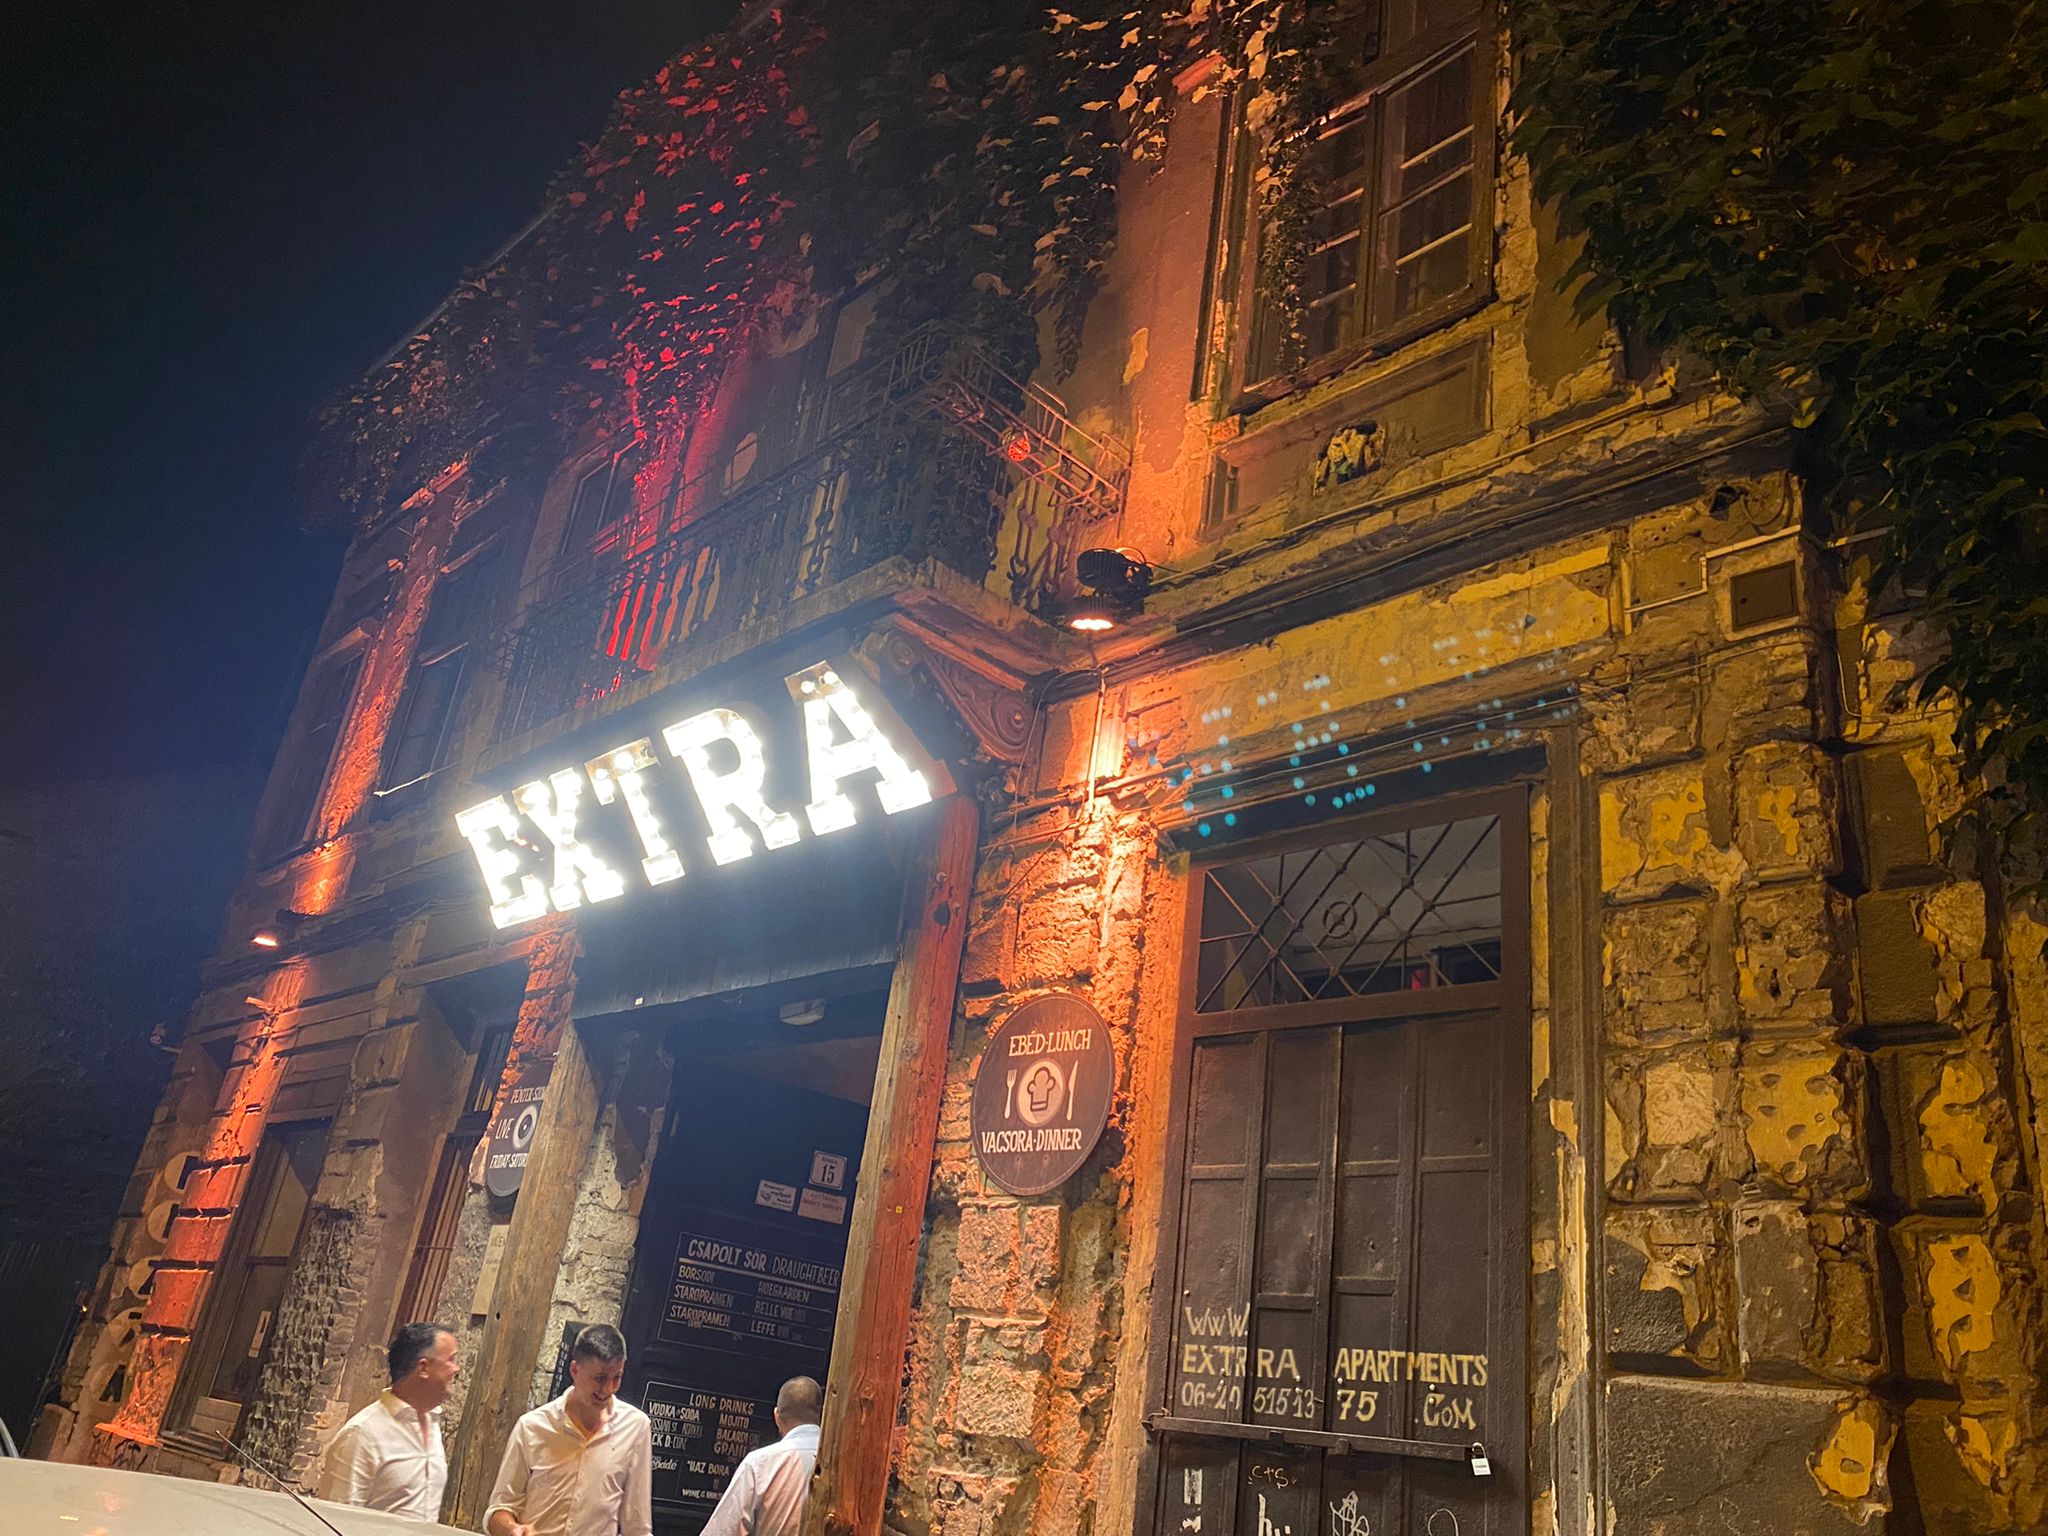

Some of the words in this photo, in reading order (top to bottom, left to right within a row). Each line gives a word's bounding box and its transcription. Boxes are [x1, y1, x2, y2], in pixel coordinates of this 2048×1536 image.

[455, 660, 935, 930] EXTRA
[495, 1118, 515, 1140] LIVE
[821, 1164, 836, 1184] 15
[688, 1239, 742, 1266] CSAPOLT
[679, 1265, 715, 1283] BORSODI
[674, 1284, 734, 1308] STAROPRAMEN
[670, 1305, 731, 1327] STAROPRAMEN
[750, 1320, 776, 1336] LEFFE
[1334, 1347, 1488, 1386] APARTMENTS
[689, 1393, 716, 1409] LONG
[719, 1398, 755, 1415] DRINKS
[719, 1413, 750, 1429] MOJITO
[707, 1463, 730, 1477] BORA
